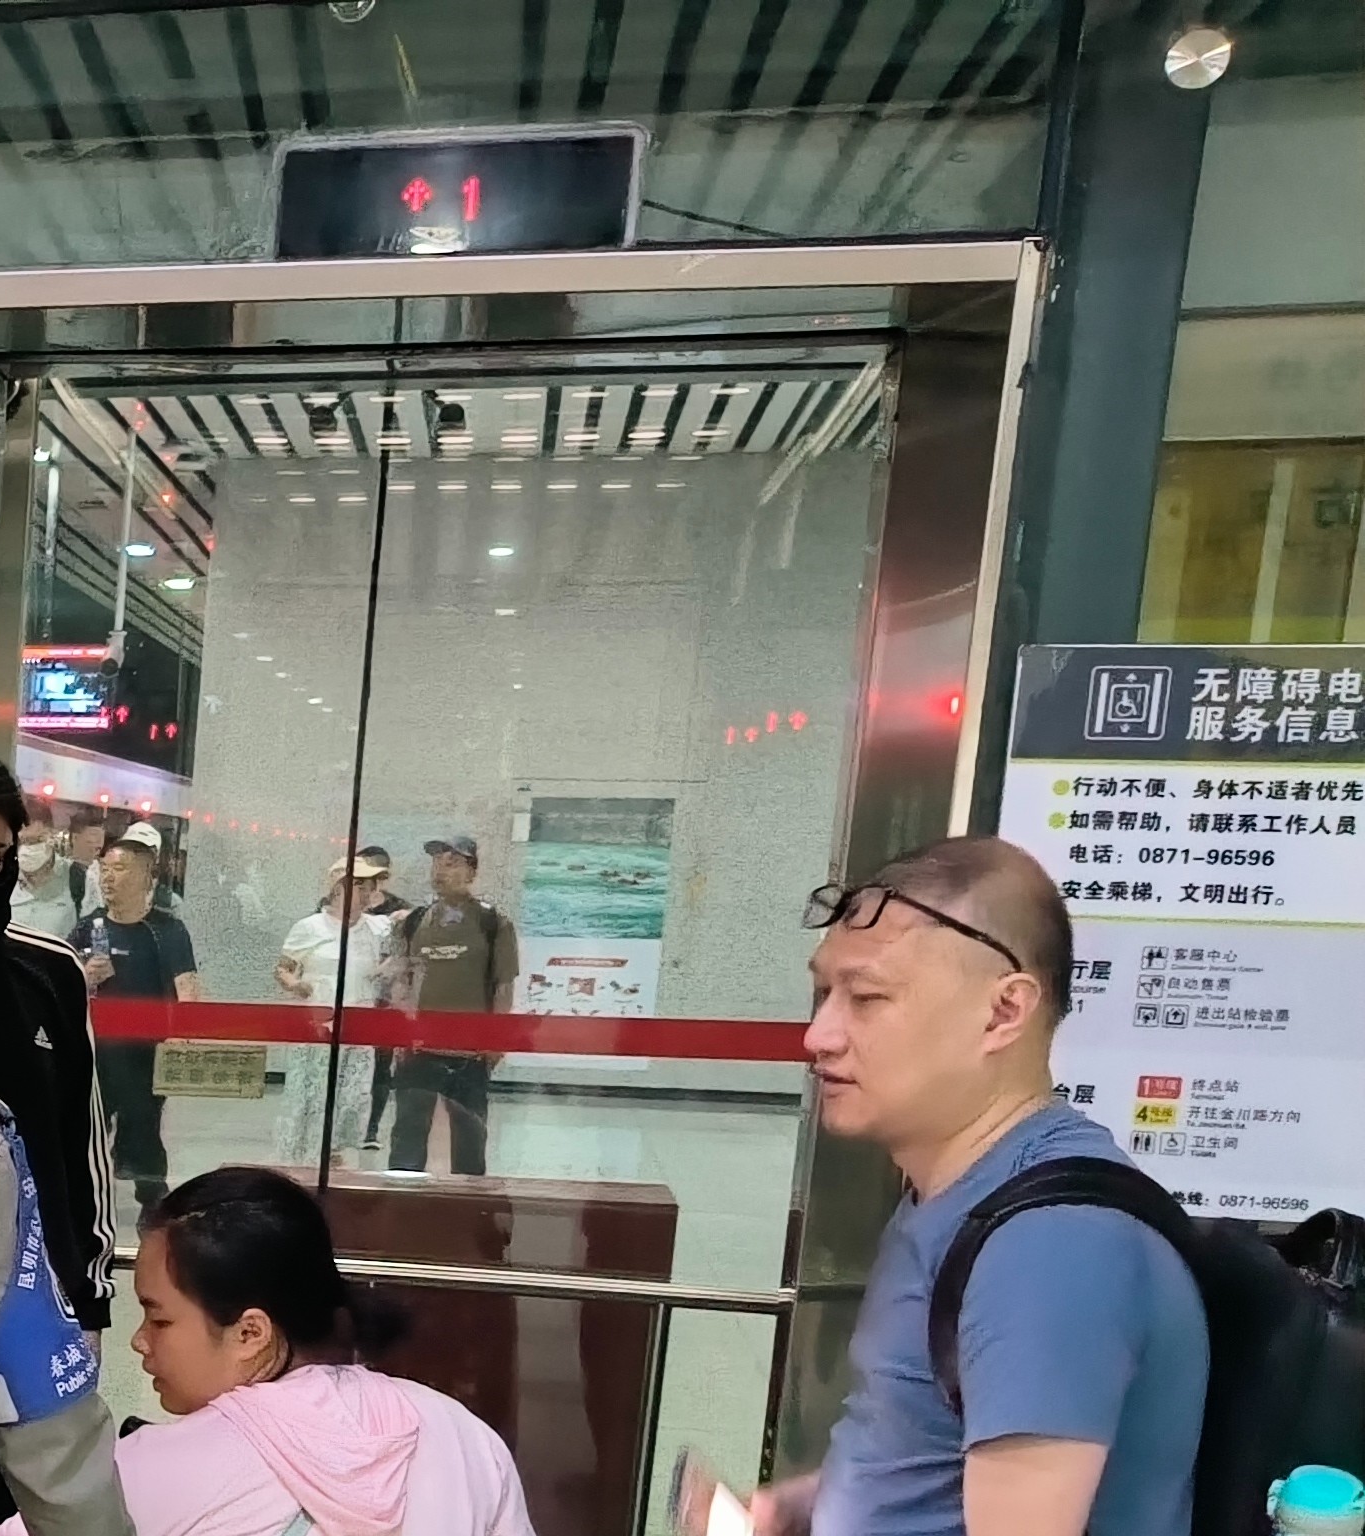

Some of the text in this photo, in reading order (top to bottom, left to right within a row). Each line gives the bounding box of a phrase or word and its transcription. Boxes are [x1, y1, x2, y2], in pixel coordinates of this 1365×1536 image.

[1191, 667, 1365, 704] 无障碍电
[1185, 707, 1360, 744] 服务信息
[1072, 777, 1364, 802] 行动不便、身体不适者优先
[1068, 811, 1357, 836] 如需帮助，请联系工作人员
[55, 1373, 89, 1398] Public
